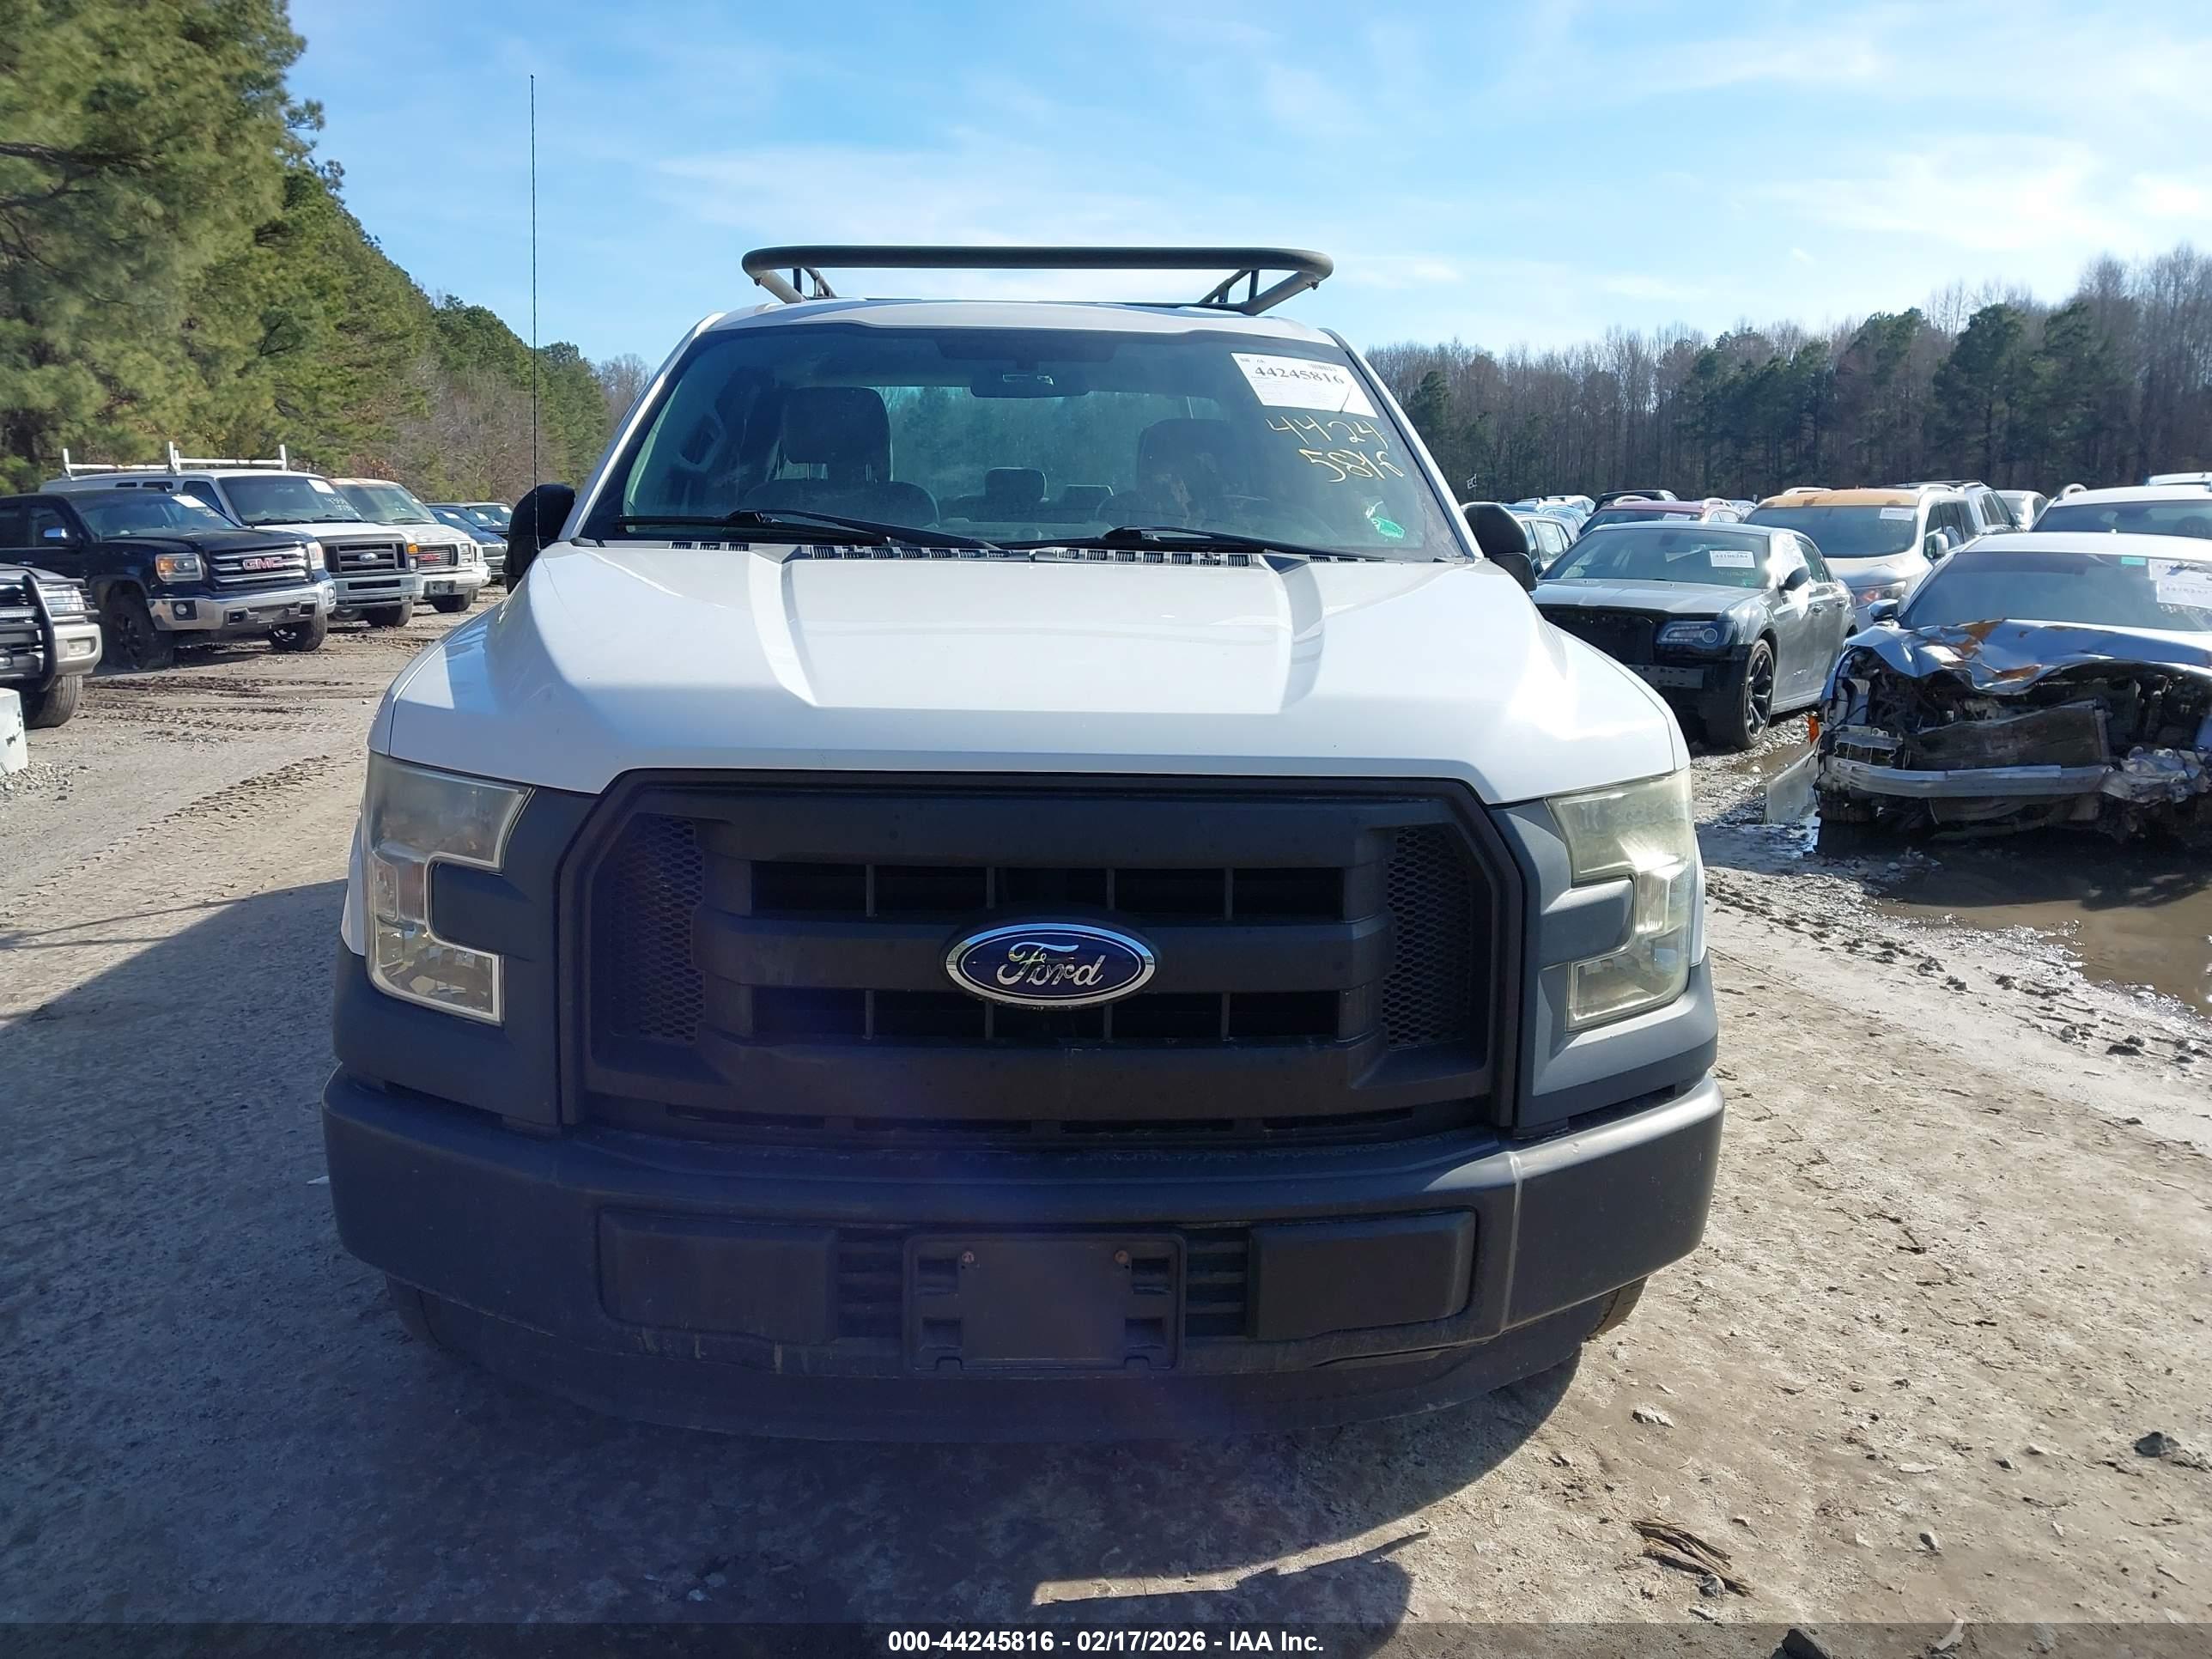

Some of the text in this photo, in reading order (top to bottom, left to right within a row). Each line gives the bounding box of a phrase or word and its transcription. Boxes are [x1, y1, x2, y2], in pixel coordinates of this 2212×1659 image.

[1255, 367, 1345, 385] 44245816
[1265, 415, 1389, 450] 4424
[242, 556, 283, 571] GMC
[996, 941, 1107, 986] Ford
